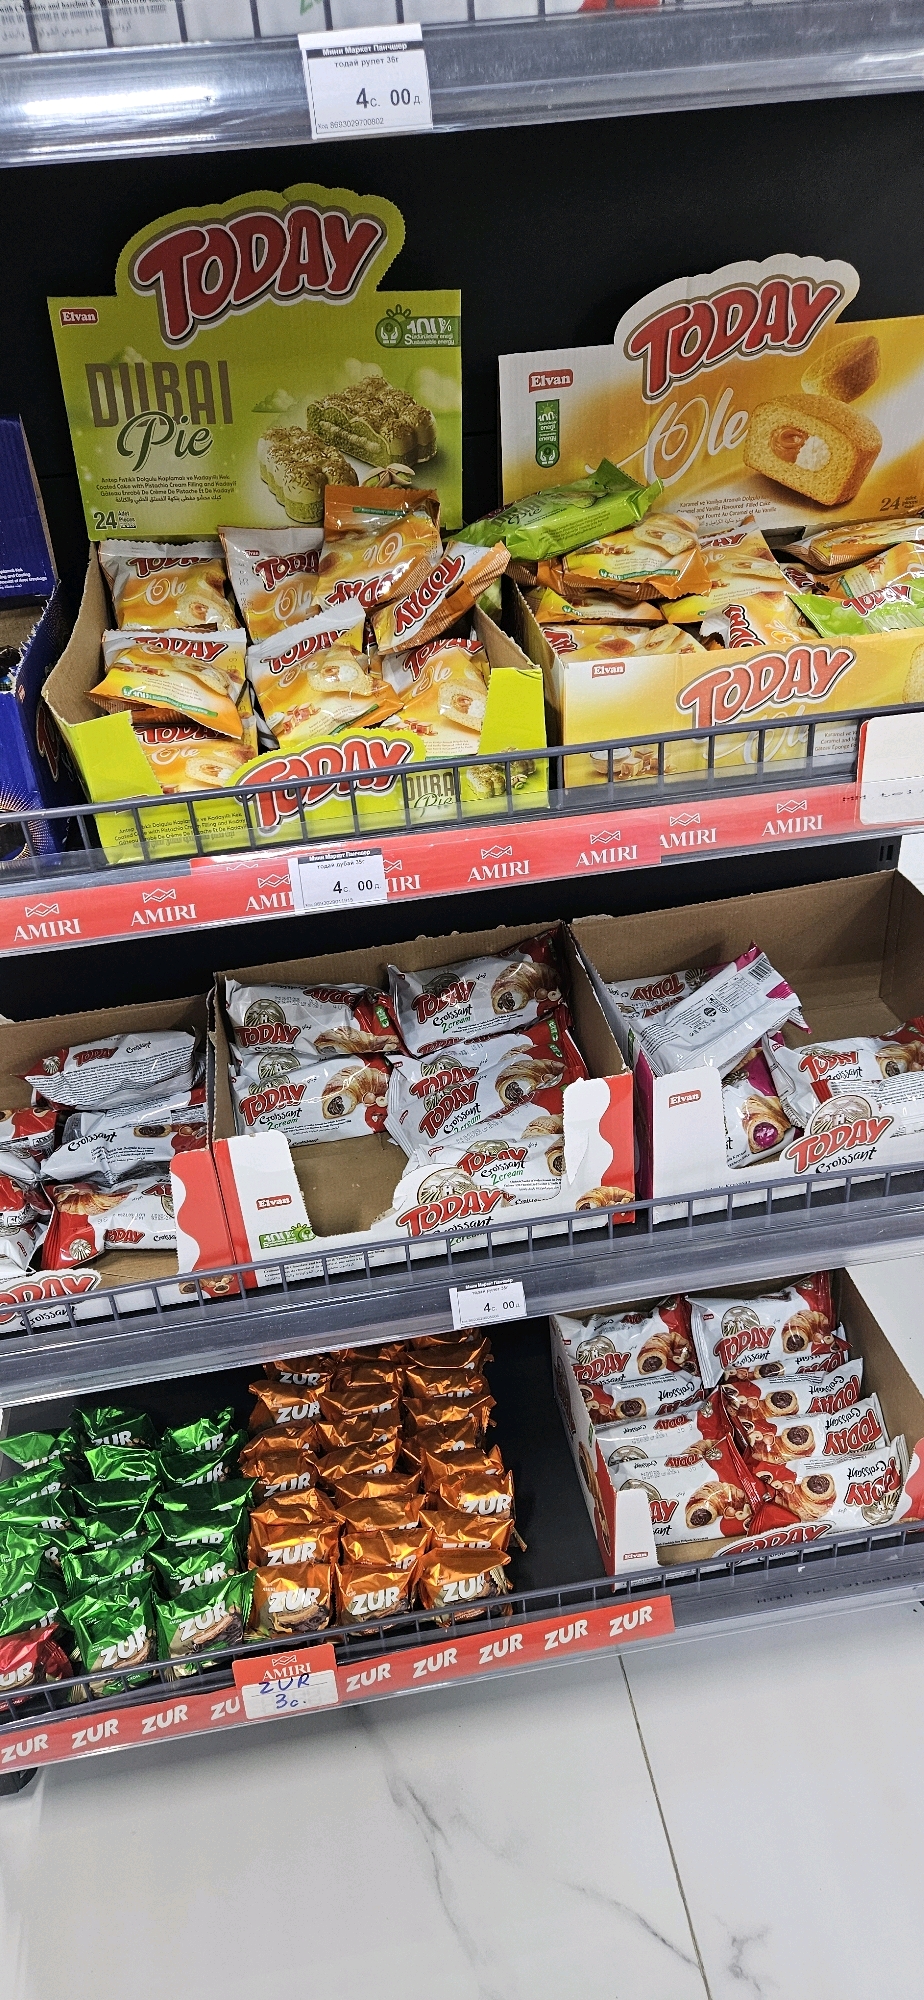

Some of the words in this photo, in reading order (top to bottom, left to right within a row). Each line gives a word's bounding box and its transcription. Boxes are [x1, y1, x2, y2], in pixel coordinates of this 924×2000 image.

[132, 204, 385, 343] TODAY
[61, 309, 97, 324] Elvan
[629, 279, 840, 397] TODAY
[84, 359, 235, 429] DUBAI
[531, 374, 571, 388] Elvan
[115, 409, 215, 473] Pie
[640, 387, 750, 487] Ole
[145, 481, 169, 489] Pistachio
[187, 480, 203, 489] Filling
[879, 496, 901, 512] 24
[93, 511, 118, 530] 24
[362, 532, 404, 567] Ole
[145, 576, 188, 606] Ole
[394, 555, 466, 637] TODAY
[412, 660, 453, 698] Ole
[592, 663, 625, 676] Elvan
[679, 647, 852, 738] TODAY
[150, 746, 200, 766] Ole
[239, 739, 411, 830] TODAY
[413, 792, 454, 818] Pie
[660, 827, 718, 850] AMIRI
[761, 814, 824, 838] AMIRI
[575, 844, 638, 868] AMIRI
[467, 859, 530, 883] AMIRI
[246, 890, 294, 912] AMI
[130, 903, 197, 927] AMIRI
[13, 918, 82, 943] AMIRI
[630, 974, 685, 1001] TODAY
[411, 980, 476, 1025] TODAY
[432, 1006, 474, 1027] Croissant
[126, 1041, 153, 1055] Croissant
[233, 1021, 302, 1048] TODAY
[239, 1083, 308, 1128] TODAY
[418, 1081, 480, 1139] TODAY
[669, 1092, 701, 1106] Elvan
[258, 1107, 304, 1126] Croissant
[442, 1103, 482, 1135] Croissant
[67, 1130, 118, 1153] Croissant
[787, 1116, 893, 1174] TODAY
[480, 1158, 527, 1180] Croissant
[815, 1146, 878, 1174] Croissant
[257, 1196, 292, 1209] Elvan
[396, 1187, 503, 1238] TODAY
[714, 1325, 776, 1368] TODAY
[280, 1371, 321, 1387] ZUR
[657, 1381, 696, 1402] Croissant
[809, 1376, 845, 1394] Croissant
[275, 1401, 322, 1425] ZUR
[652, 1414, 693, 1430] TODAY
[824, 1407, 863, 1432] Croissant
[92, 1429, 133, 1446] ZUR
[823, 1408, 884, 1457] TODAY
[663, 1453, 703, 1469] TODAY
[846, 1458, 889, 1481] Croissant
[264, 1471, 311, 1498] ZUR
[845, 1457, 903, 1508] TODAY
[462, 1493, 512, 1516] ZUR
[266, 1541, 317, 1567] ZUR
[178, 1560, 228, 1595] ZUR
[268, 1586, 321, 1615] ZUR
[351, 1586, 401, 1616] ZUR
[178, 1599, 229, 1643] ZUR
[608, 1604, 654, 1638] ZUR
[100, 1624, 148, 1669] ZUR
[478, 1632, 524, 1665] ZUR
[543, 1619, 589, 1652] ZUR
[262, 1662, 312, 1681] AMIRI
[412, 1647, 458, 1679] ZUR
[258, 1672, 311, 1695] ZUR
[345, 1662, 391, 1693] ZUR
[141, 1704, 189, 1736] ZUR
[210, 1695, 242, 1721] ZU
[70, 1717, 120, 1750] ZUR
[0, 1732, 50, 1764] ZUR
